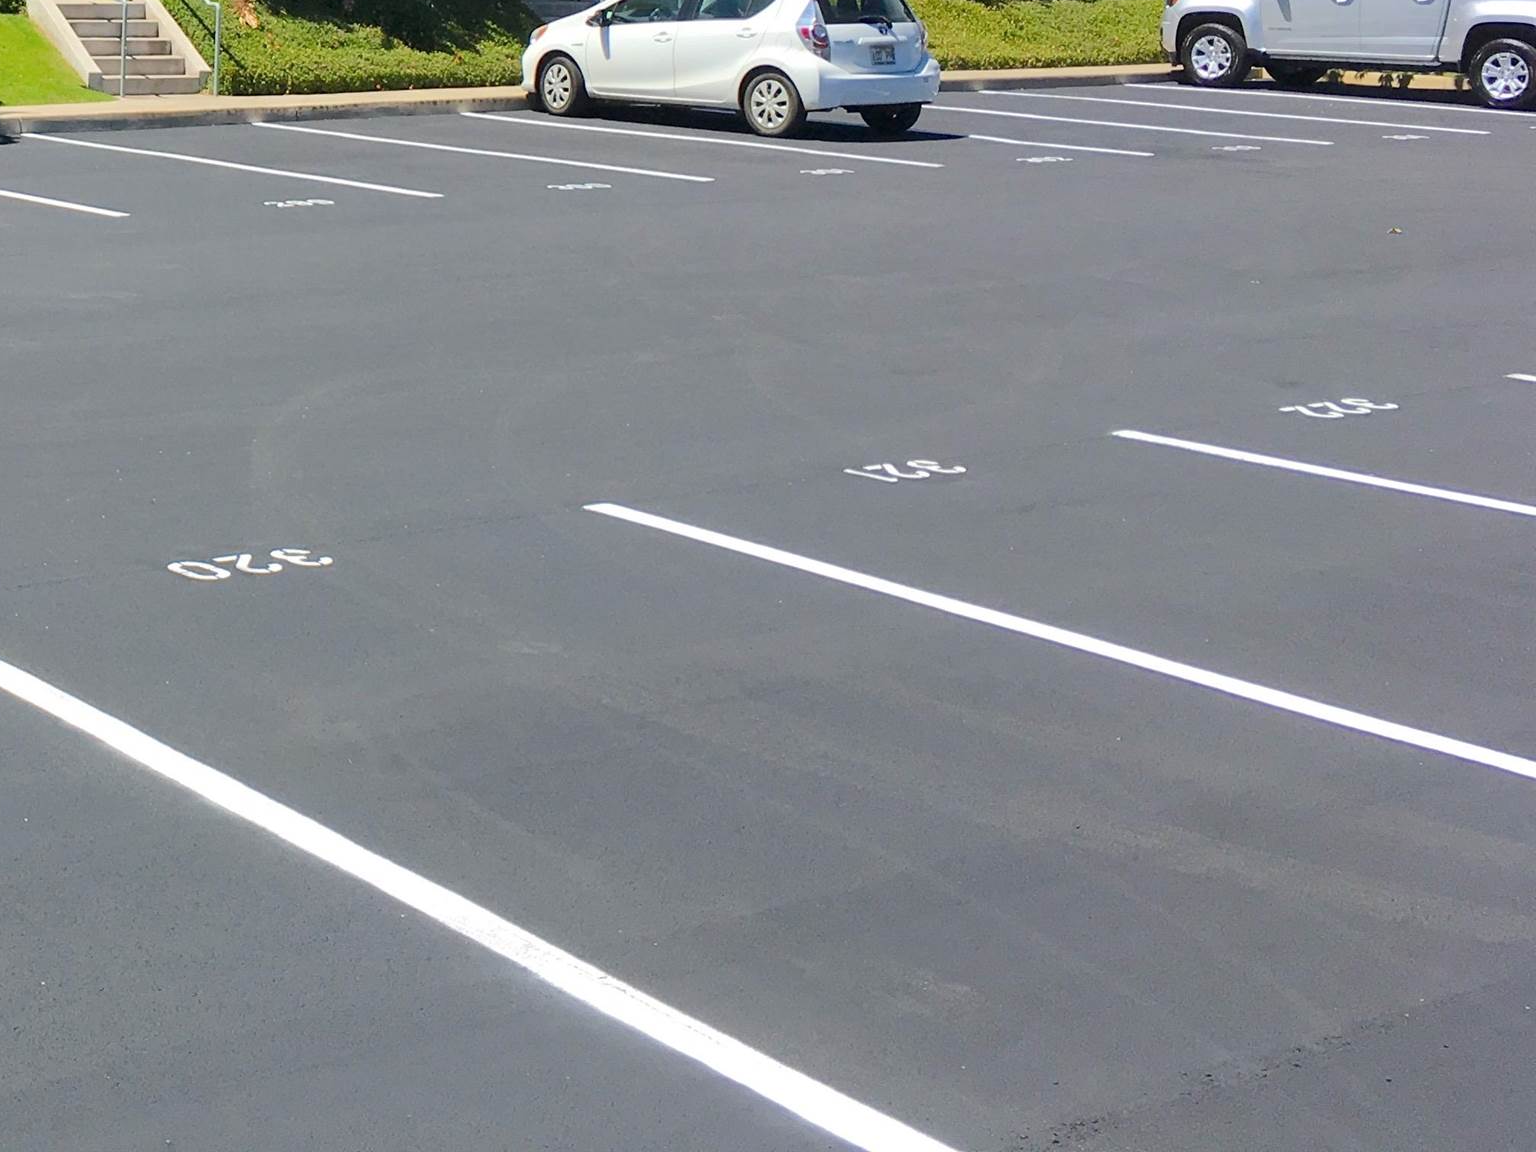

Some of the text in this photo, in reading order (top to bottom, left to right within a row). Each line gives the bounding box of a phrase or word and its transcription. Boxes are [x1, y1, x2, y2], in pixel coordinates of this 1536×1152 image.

[1278, 398, 1399, 419] 322
[843, 459, 967, 483] 321
[167, 548, 334, 581] 320
